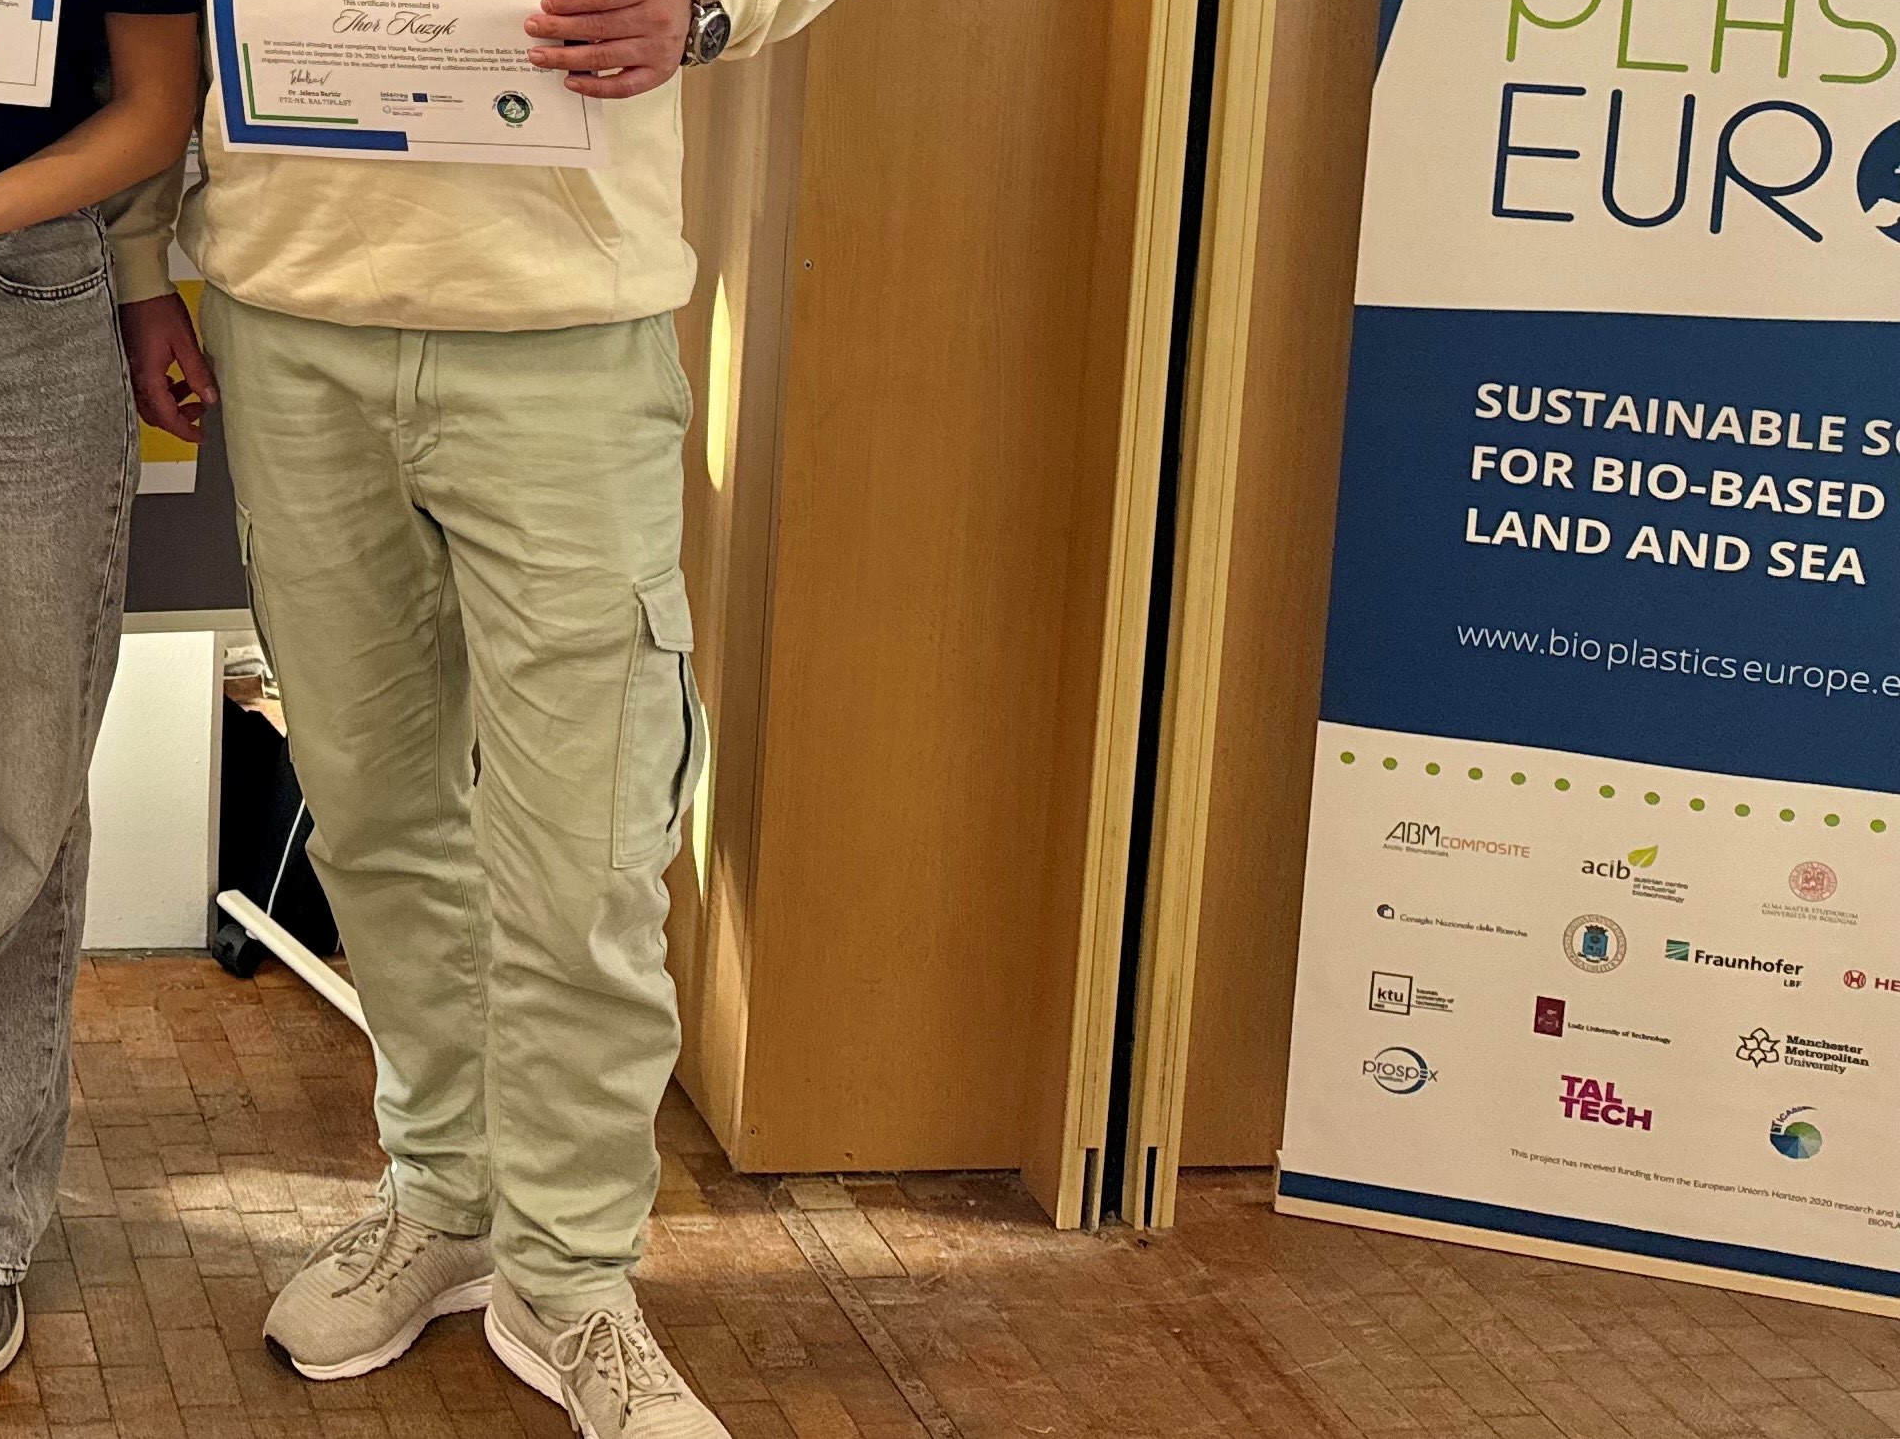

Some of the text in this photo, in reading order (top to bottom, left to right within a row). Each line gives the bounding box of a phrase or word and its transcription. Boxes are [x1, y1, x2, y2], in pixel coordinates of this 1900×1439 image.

[1492, 82, 1900, 246] EUR
[1474, 381, 1847, 453] SUSTAINABLE
[1471, 444, 1886, 521] FOR BIO-BASED
[1464, 506, 1867, 586] LAND AND SEA
[1385, 821, 1441, 848] ABM
[1440, 836, 1531, 859] COMPOSITE
[1581, 859, 1631, 880] acib
[1694, 949, 1804, 975] Fraunhofer
[1377, 986, 1404, 1003] ktu
[1785, 1045, 1869, 1066] Metropolitan
[1786, 1034, 1863, 1054] Manchester
[1784, 1056, 1846, 1075] University
[1560, 1074, 1623, 1105] TAL
[1558, 1095, 1653, 1132] TECH
[1510, 1148, 1529, 1161] This
[1529, 1151, 1561, 1167] project
[1562, 1157, 1578, 1168] has
[1579, 1160, 1617, 1174] received
[1617, 1164, 1652, 1182] funding
[1653, 1171, 1675, 1185] from
[1676, 1174, 1692, 1188] the
[1693, 1178, 1736, 1194] European
[1771, 1188, 1808, 1204] Horizon
[1808, 1194, 1834, 1209] 2020
[1833, 1199, 1874, 1215] research
[1875, 1204, 1895, 1218] and
